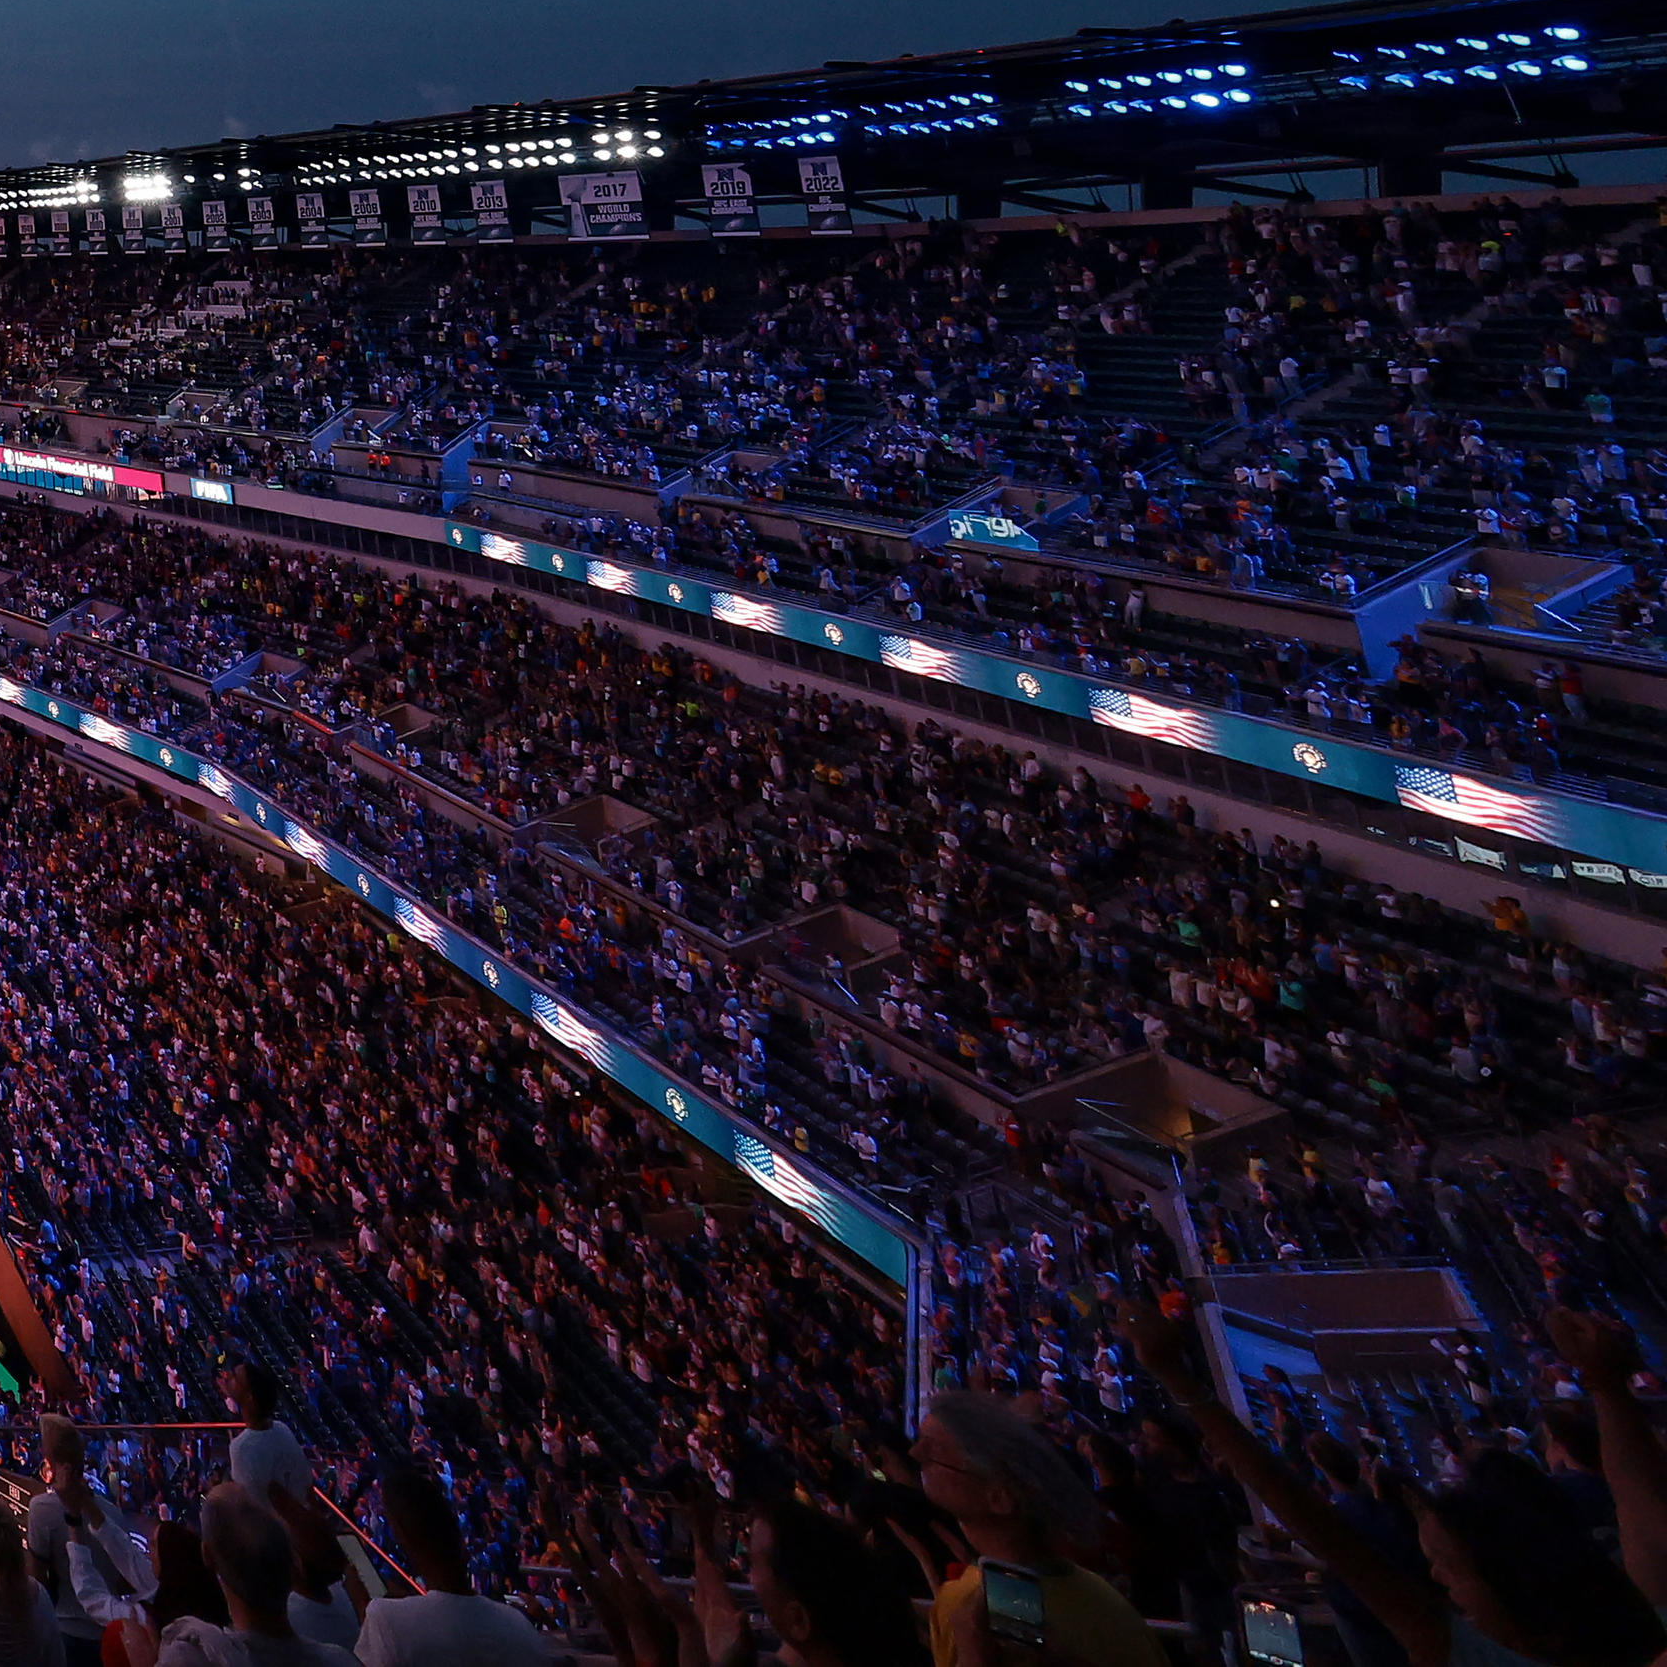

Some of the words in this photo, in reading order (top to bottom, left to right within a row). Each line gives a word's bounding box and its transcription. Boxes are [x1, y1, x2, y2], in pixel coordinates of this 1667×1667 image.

[710, 181, 746, 195] 2019
[805, 176, 840, 191] 2022
[593, 183, 627, 198] 2017
[413, 200, 437, 212] 2010
[476, 196, 504, 209] 2013
[596, 203, 630, 214] WORLD
[251, 209, 272, 221] 2003
[300, 205, 322, 218] 2004
[589, 212, 642, 224] CHAMPIONS
[14, 451, 47, 469] Lincoln
[47, 456, 88, 476] Financial
[88, 462, 115, 482] Field
